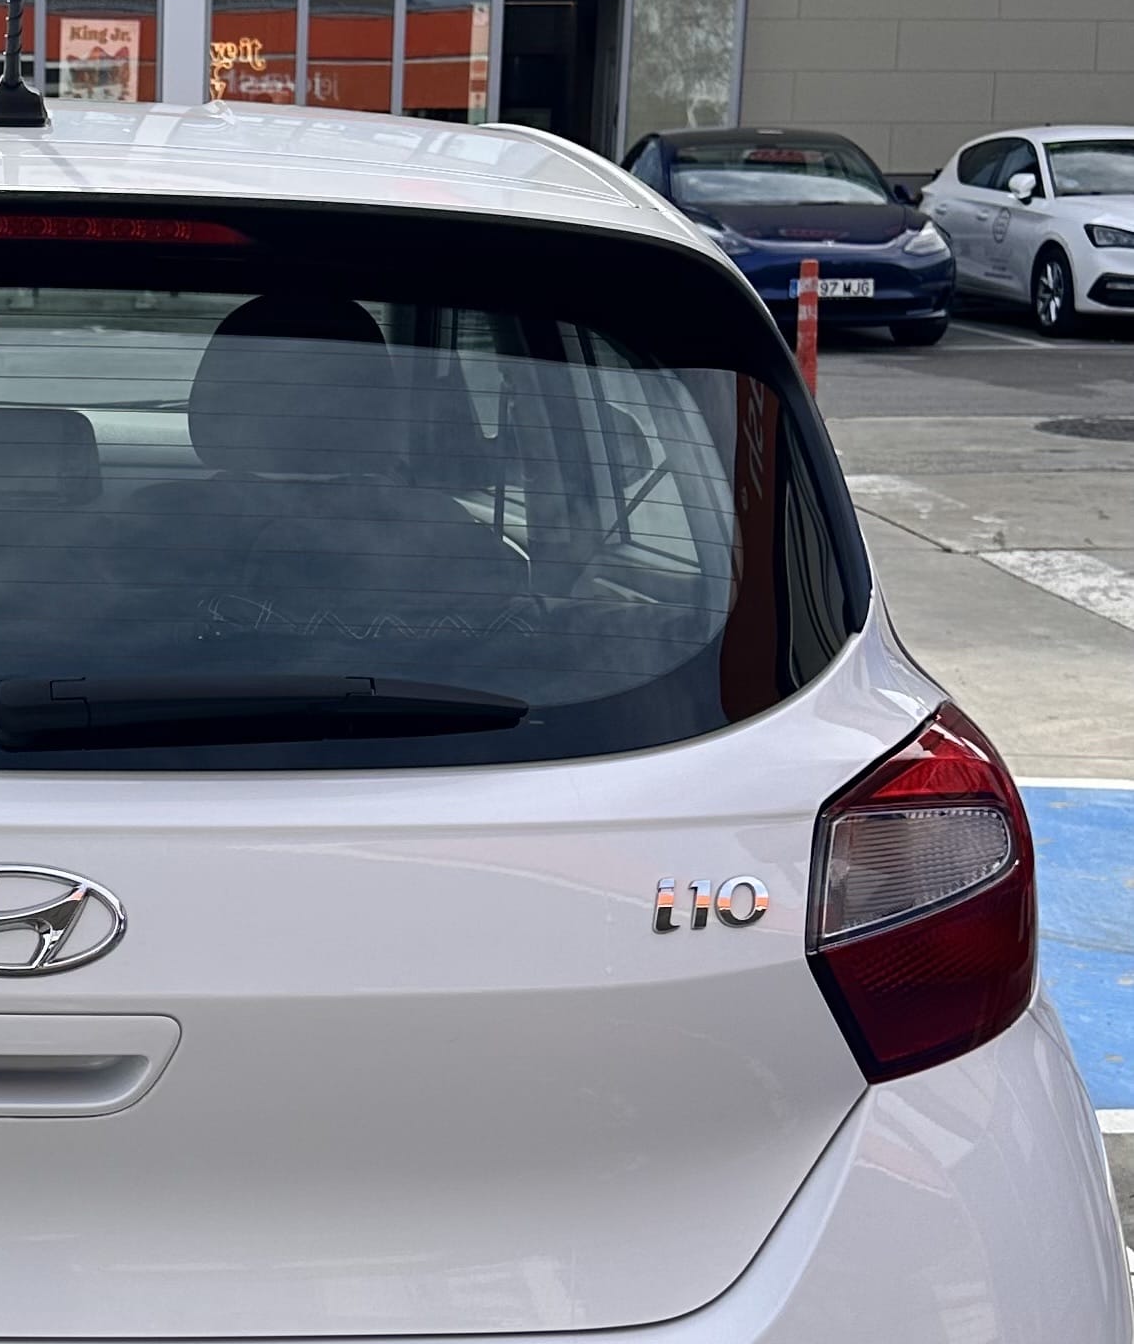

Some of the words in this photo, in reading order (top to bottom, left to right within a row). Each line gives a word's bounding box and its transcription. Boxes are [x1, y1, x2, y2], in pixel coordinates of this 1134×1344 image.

[69, 25, 108, 45] King
[110, 27, 132, 43] Jr.
[842, 281, 870, 296] MJG
